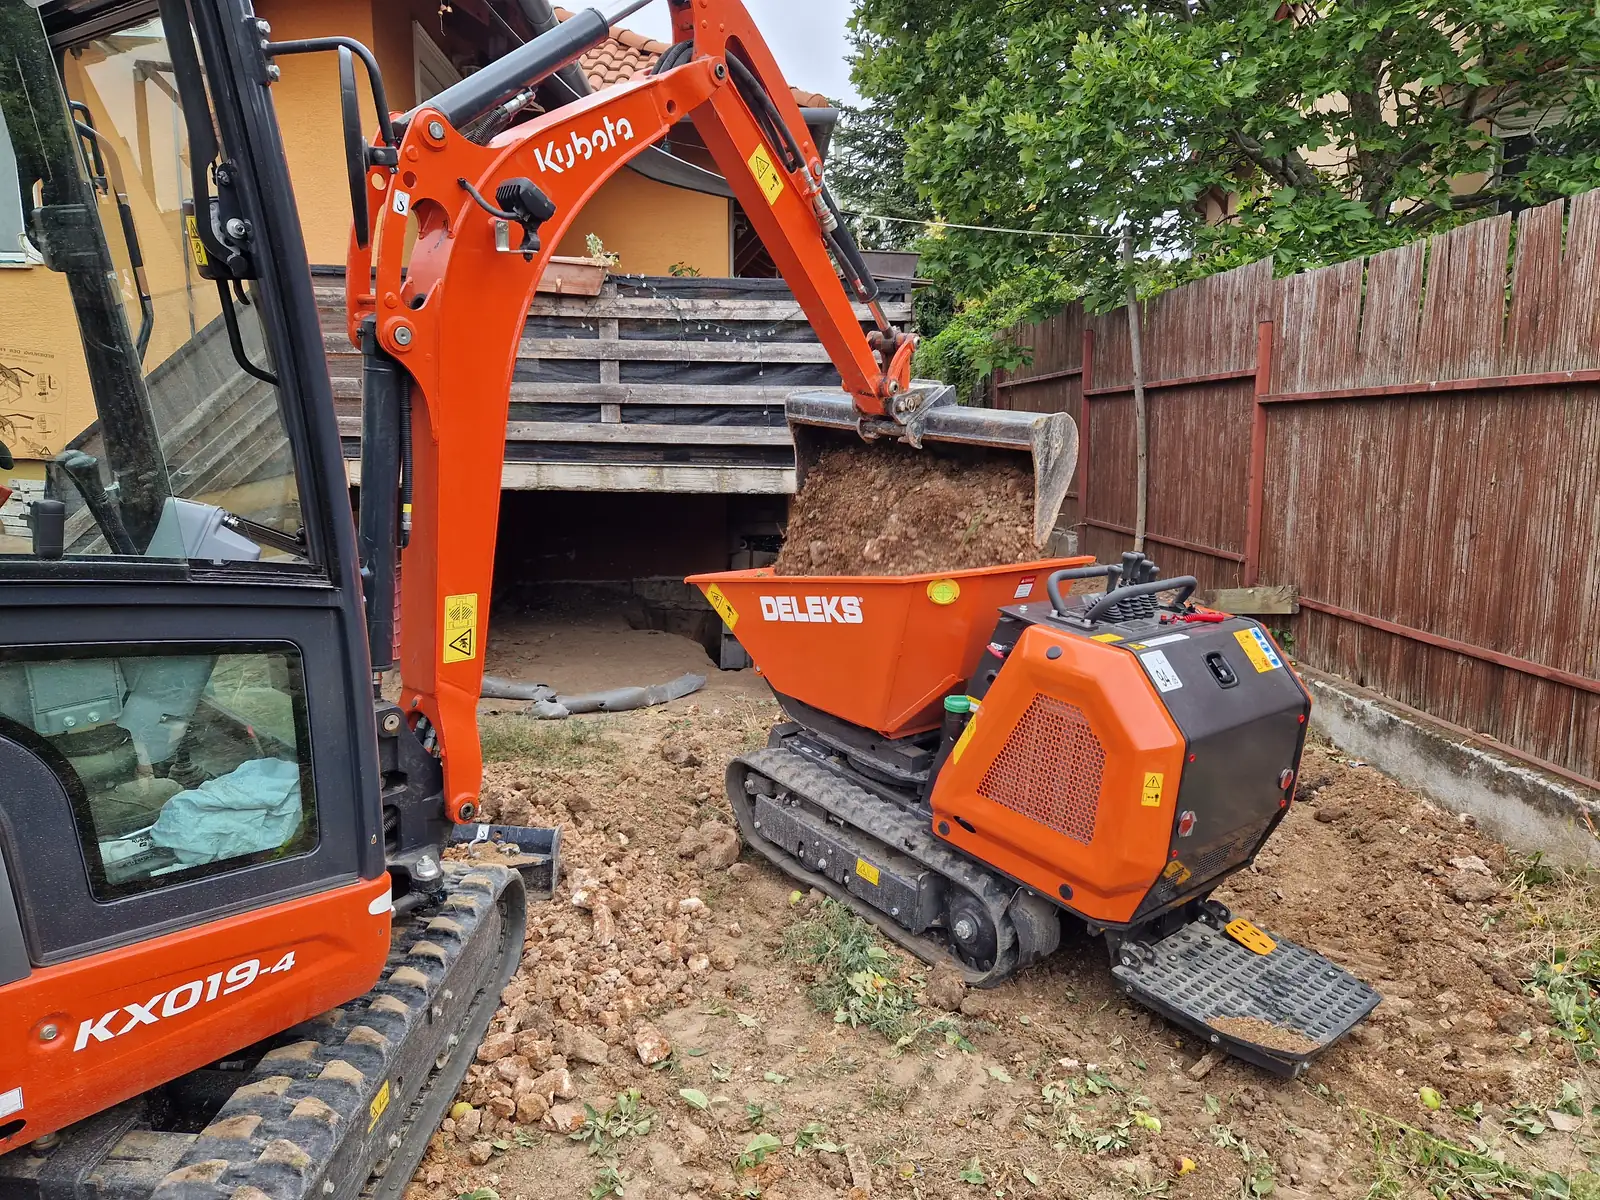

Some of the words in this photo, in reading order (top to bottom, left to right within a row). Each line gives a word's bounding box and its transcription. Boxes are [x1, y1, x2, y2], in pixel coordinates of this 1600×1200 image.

[533, 115, 635, 174] Kubota
[759, 595, 864, 624] DELEKS
[73, 950, 297, 1053] KX019-4
